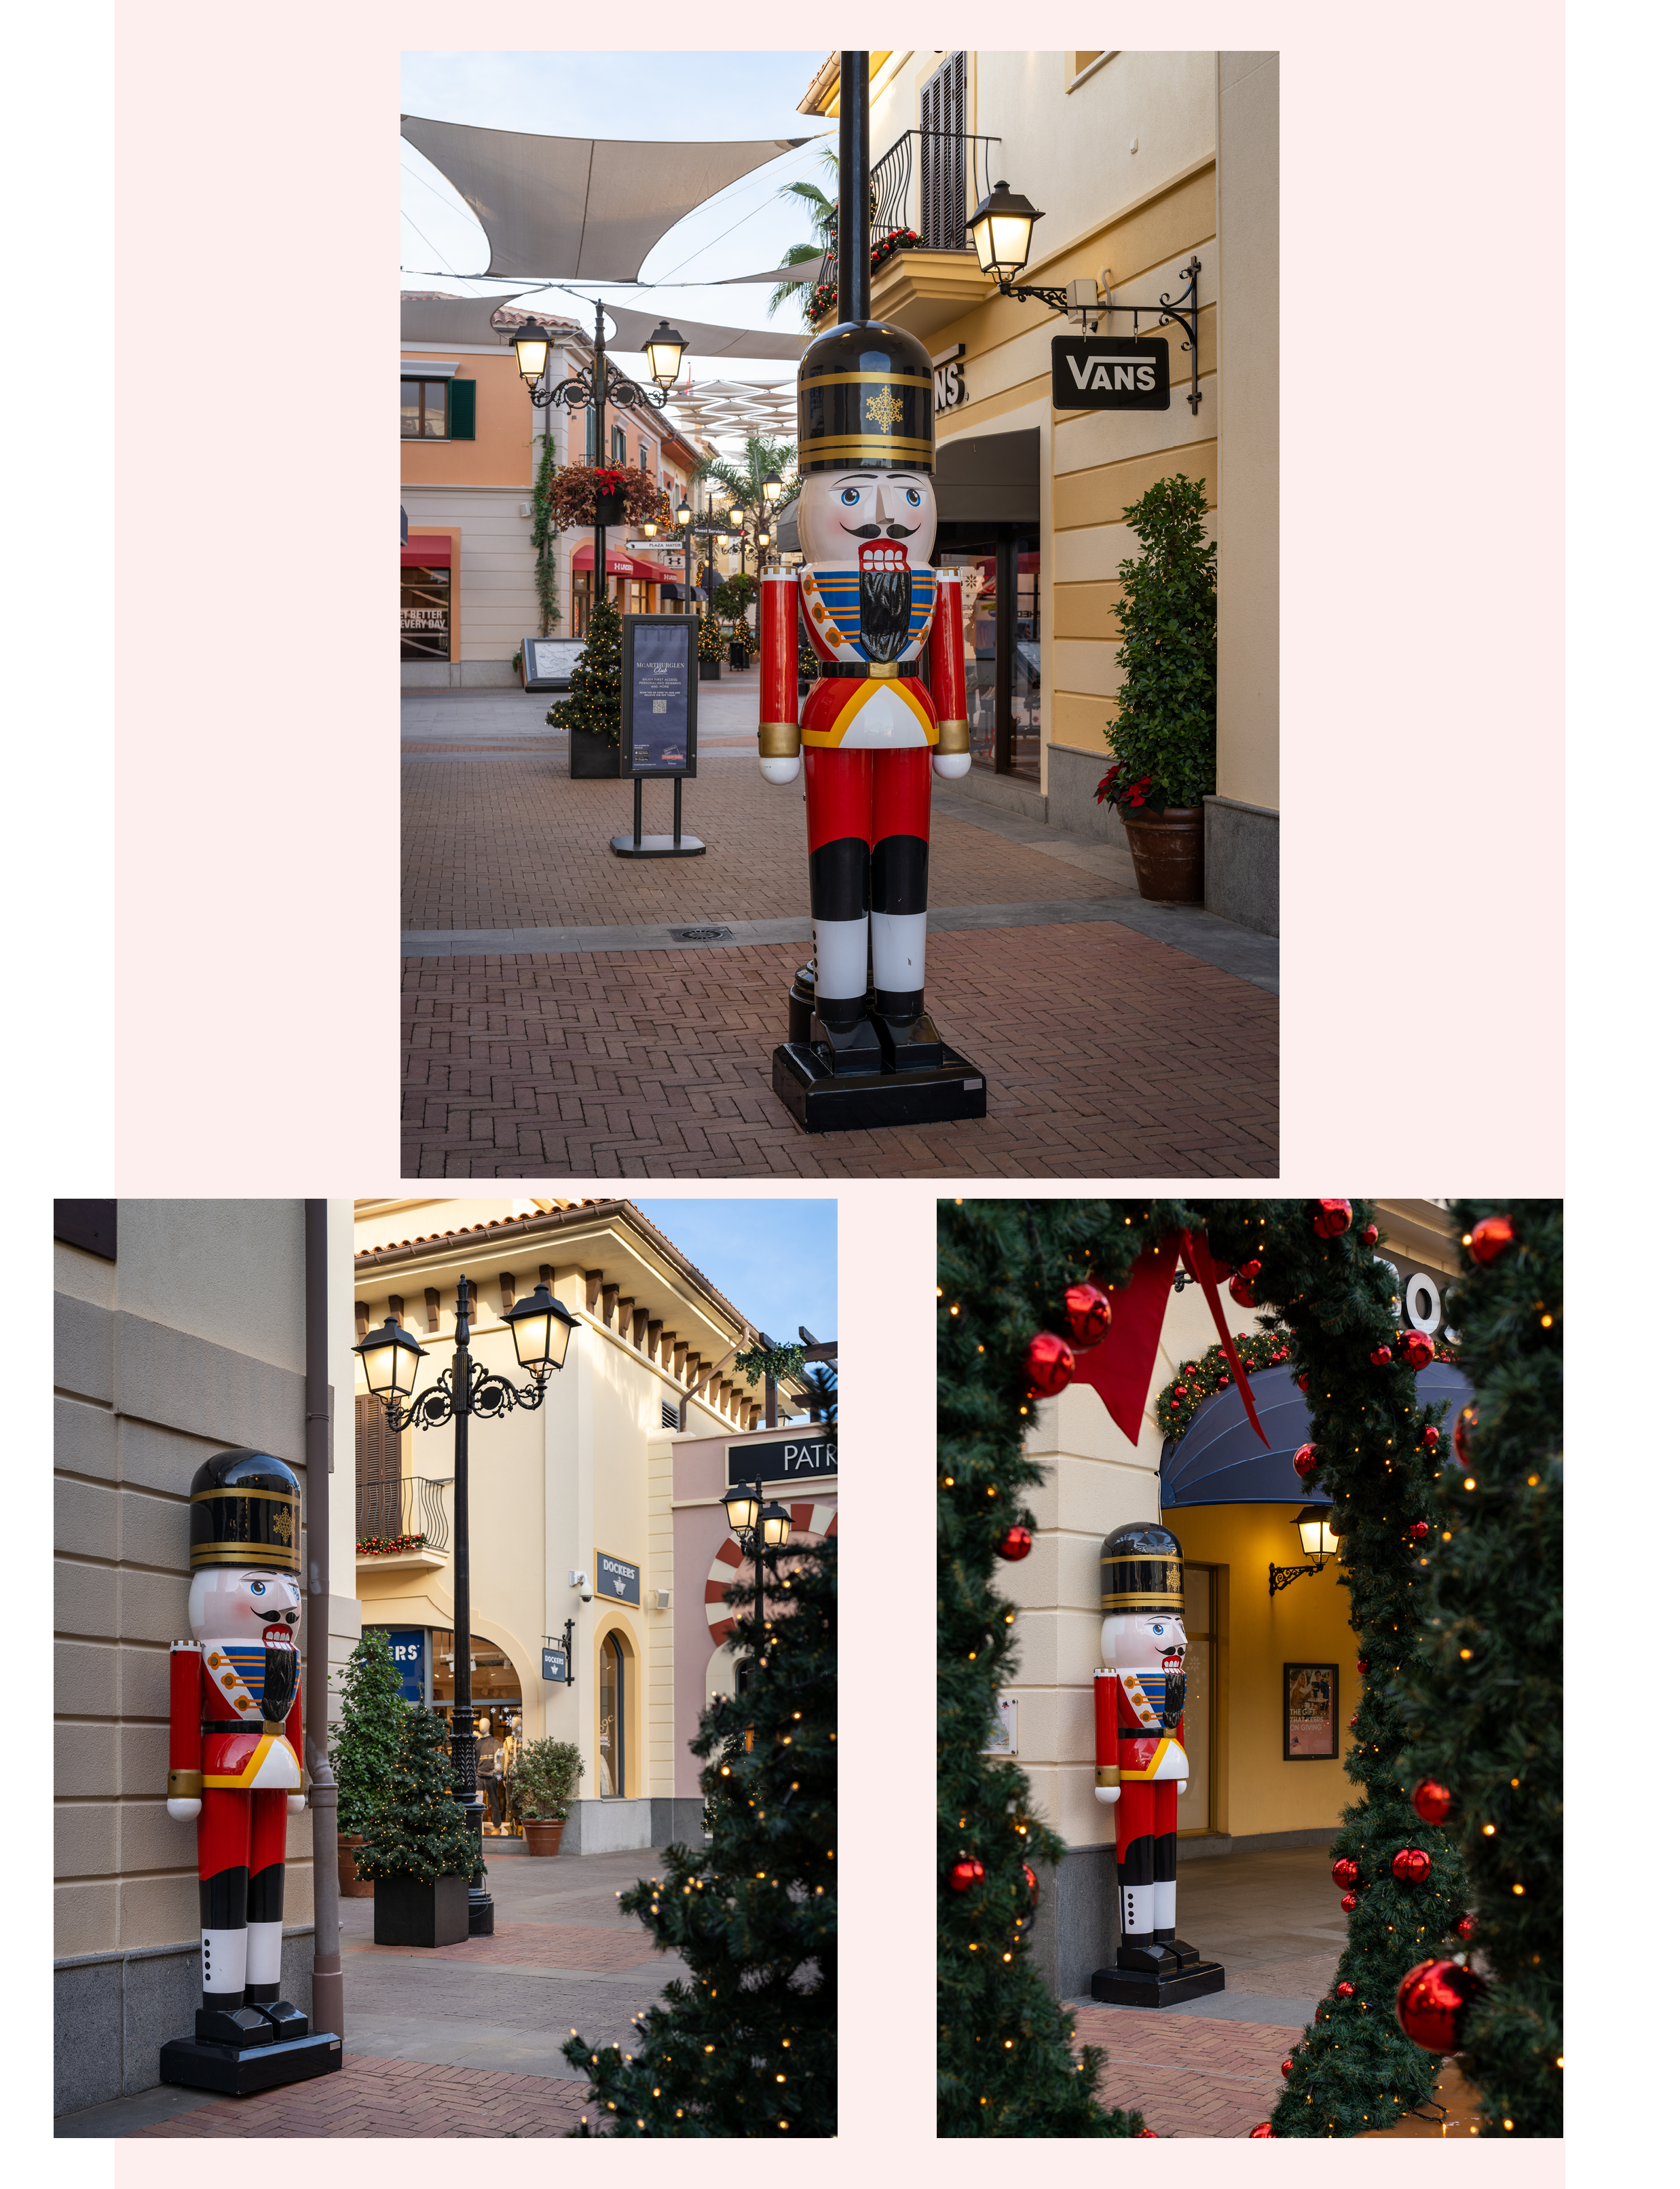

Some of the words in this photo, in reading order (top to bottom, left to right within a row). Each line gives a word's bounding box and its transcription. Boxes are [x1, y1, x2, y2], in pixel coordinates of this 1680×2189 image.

[1066, 355, 1156, 391] VANS
[934, 362, 965, 411] NS
[400, 619, 426, 629] EVERY
[428, 619, 445, 629] DAY
[410, 610, 442, 618] BETTER
[785, 1443, 838, 1470] PATR
[603, 1558, 635, 1580] DOCKERS
[544, 1655, 564, 1665] DOCKERS
